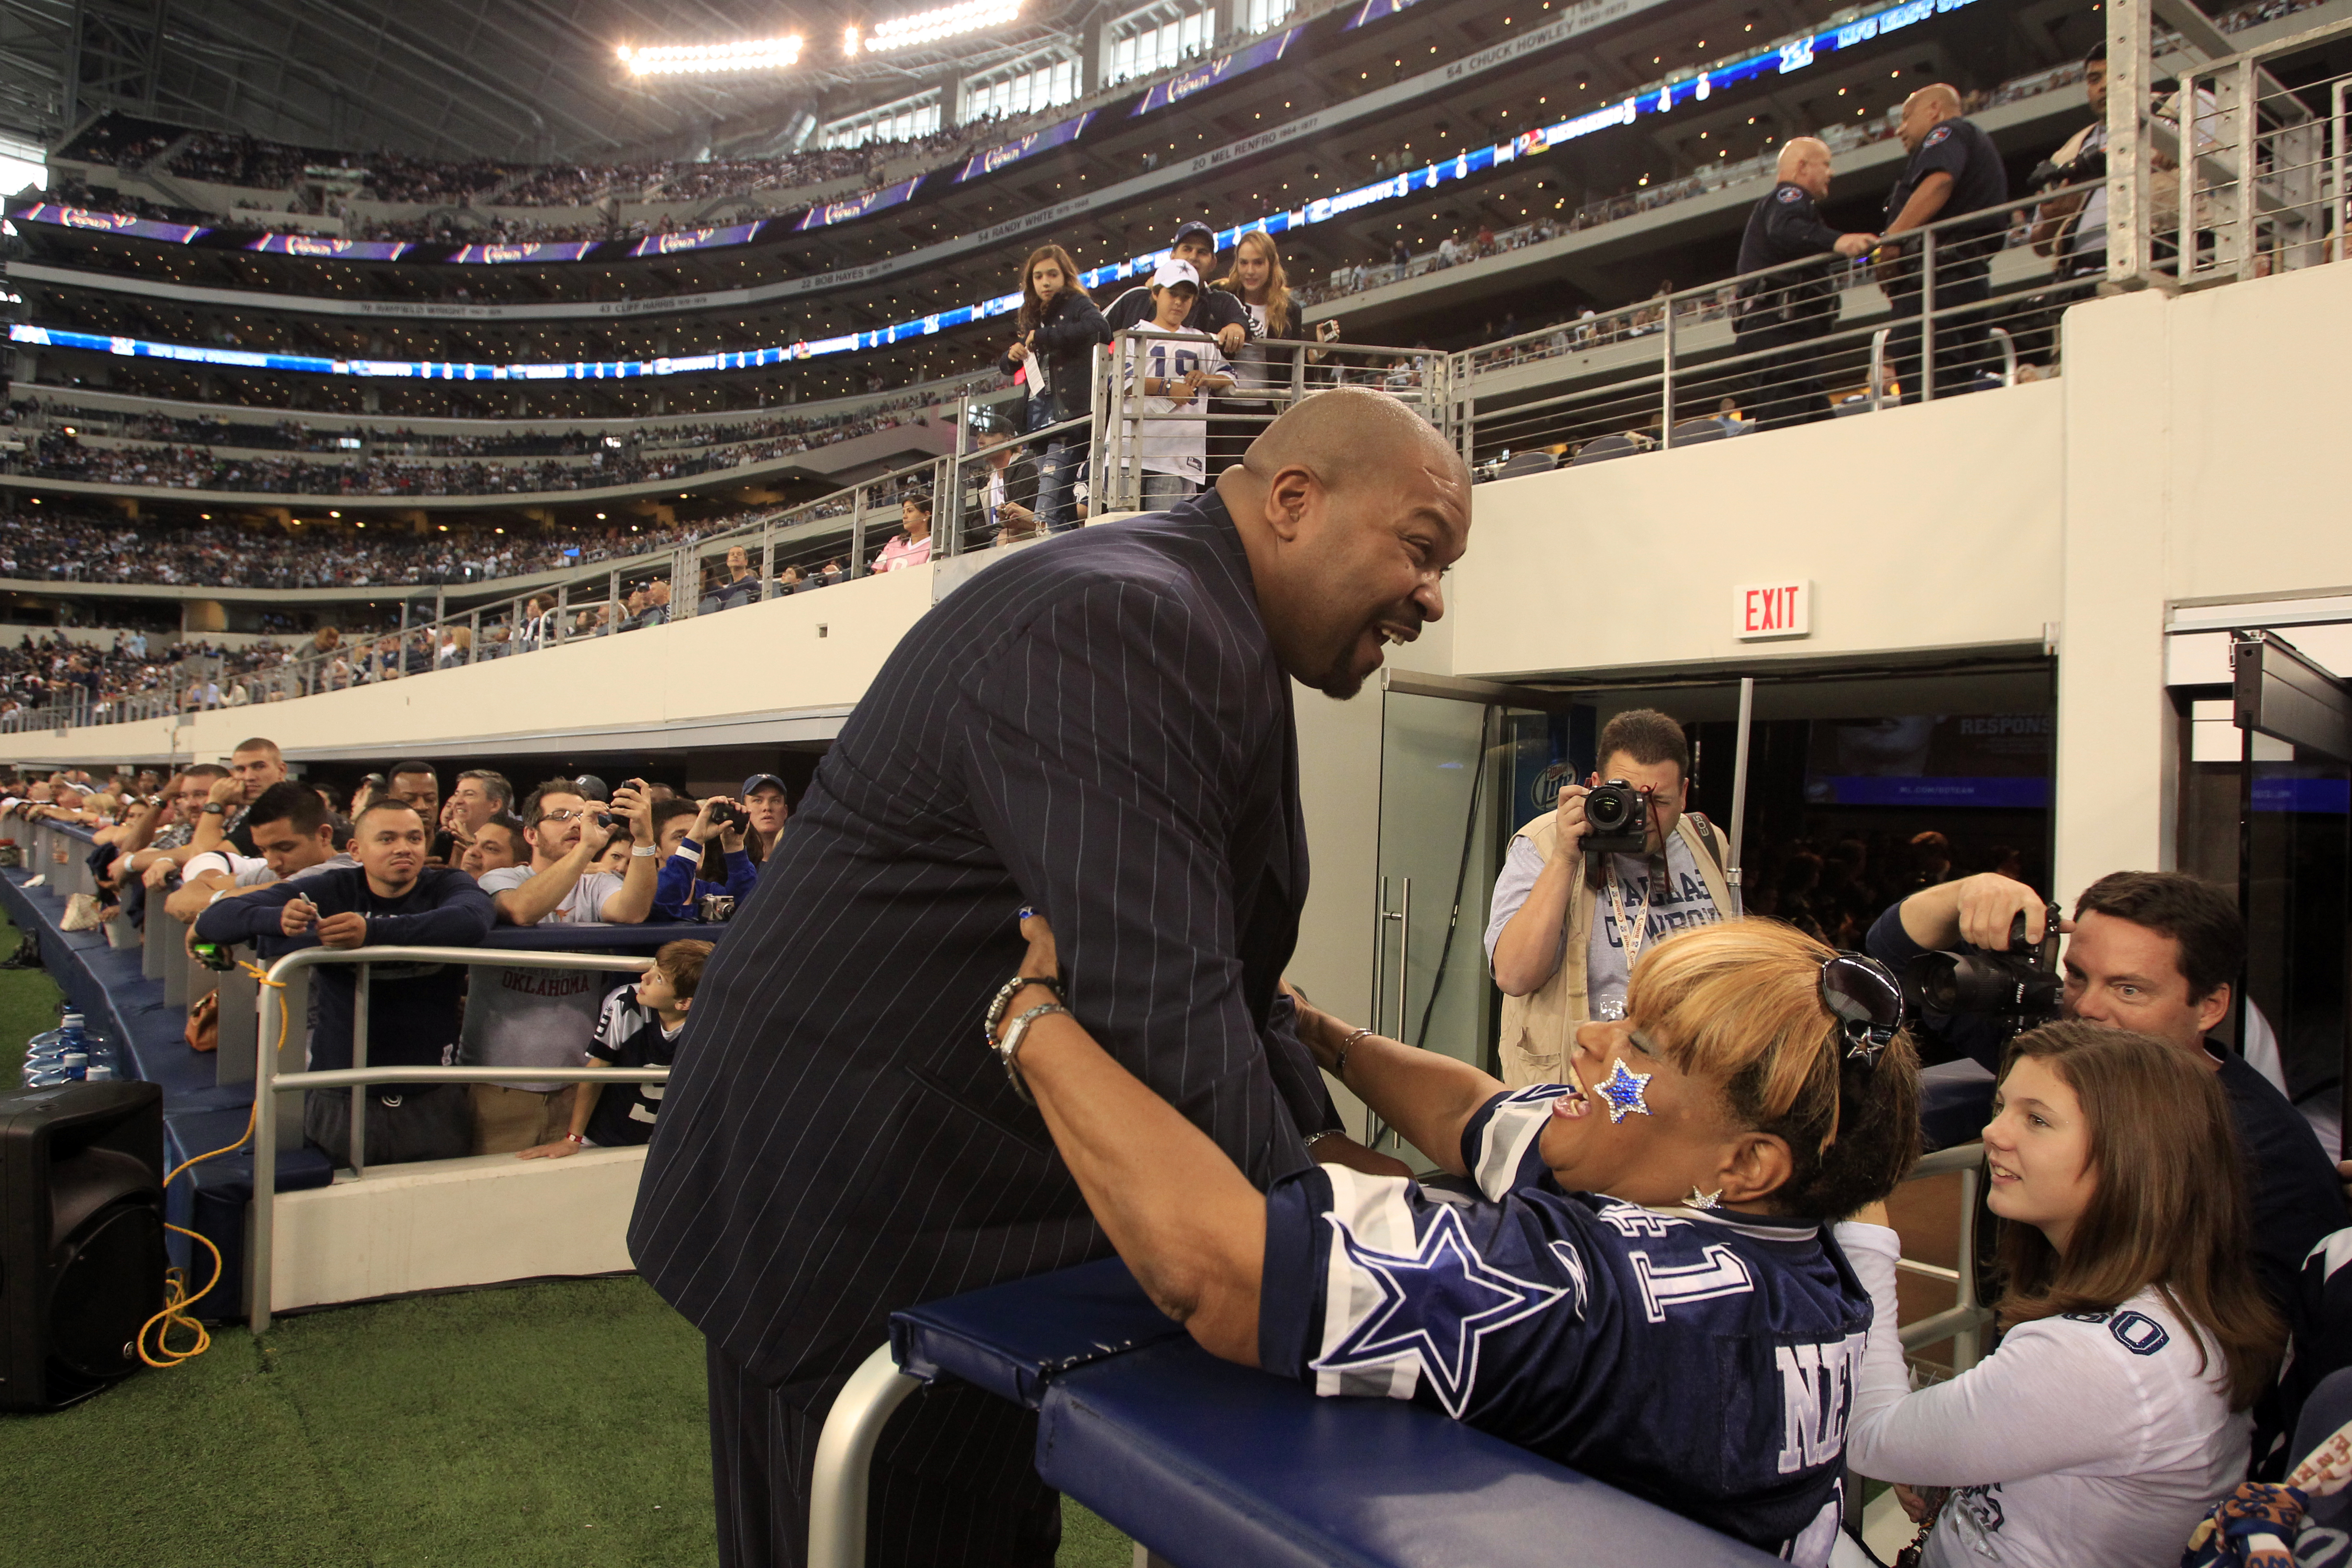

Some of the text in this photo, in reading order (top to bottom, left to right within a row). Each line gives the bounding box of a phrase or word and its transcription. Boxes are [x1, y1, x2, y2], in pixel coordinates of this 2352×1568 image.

[1469, 46, 1513, 70] CHUCK
[1516, 21, 1574, 52] HOWLEY
[1192, 158, 1206, 172] 20
[1210, 150, 1231, 164] MEL
[1234, 132, 1276, 156] RENFRO
[1331, 181, 1394, 214] COWBOYS
[992, 215, 1022, 237] RANDY
[1025, 208, 1054, 227] WHITE
[815, 273, 833, 285] BOB
[835, 268, 864, 282] HAYES
[615, 302, 639, 312] CLIFF
[642, 297, 675, 310] HARRIS
[1746, 586, 1799, 631] EXIT
[1692, 815, 1710, 837] EOS
[1615, 899, 1624, 922] Canon
[1634, 917, 1644, 939] Canon
[502, 970, 590, 997] OKLAHOMA
[2016, 983, 2025, 1004] Nikon
